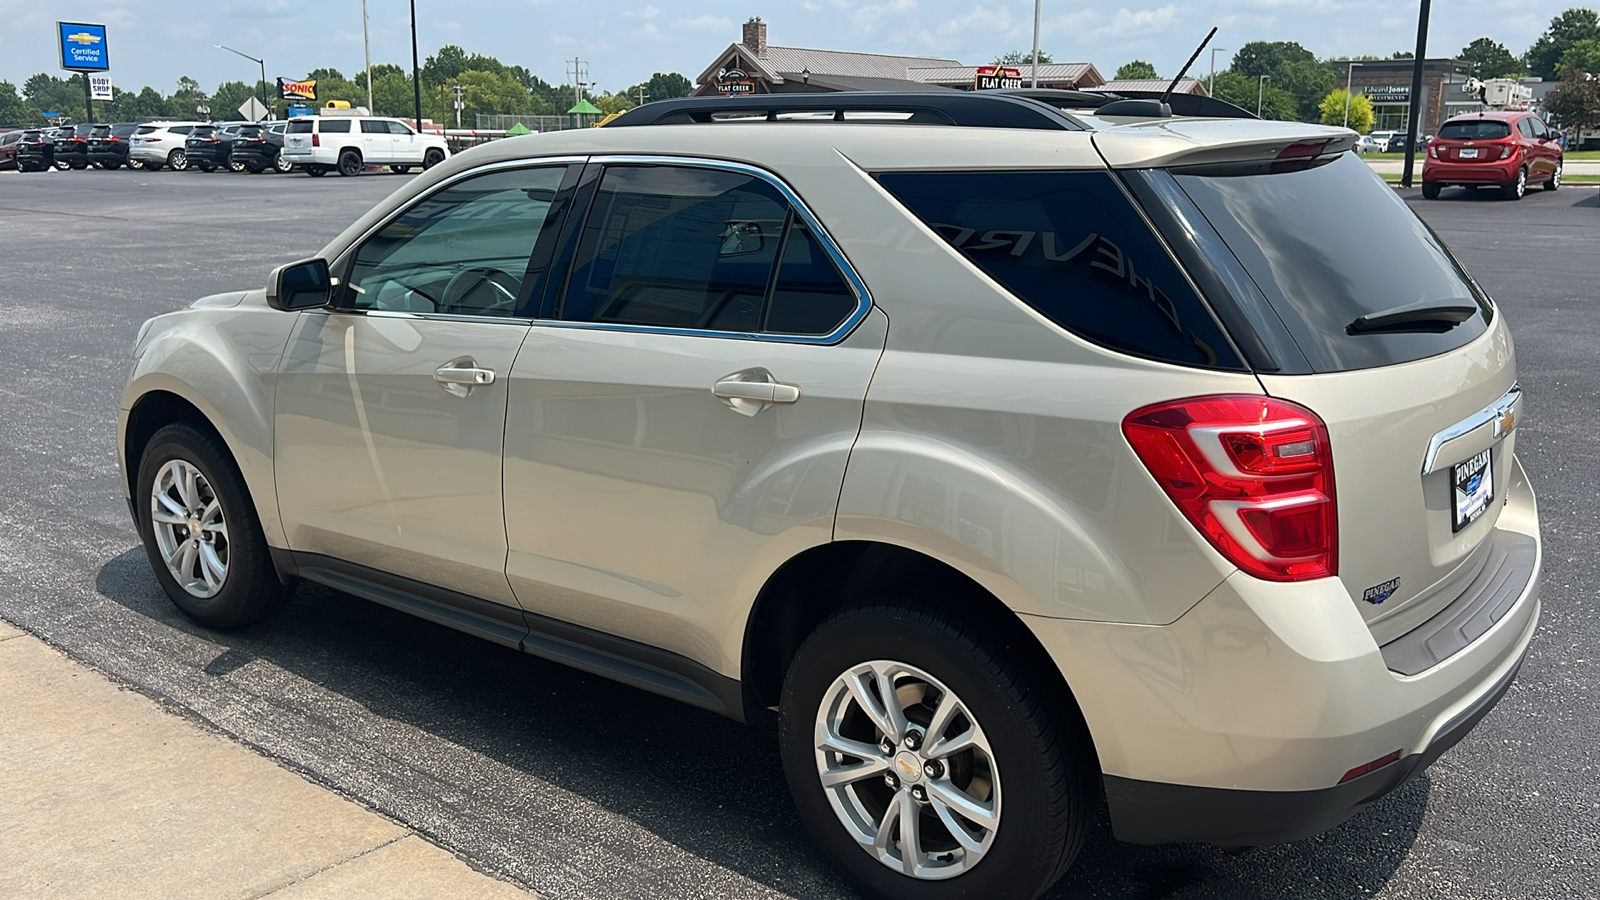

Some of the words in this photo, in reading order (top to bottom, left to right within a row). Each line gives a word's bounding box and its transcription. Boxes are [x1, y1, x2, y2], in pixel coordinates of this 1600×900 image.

[71, 47, 100, 56] Certified
[981, 77, 999, 89] FLAT
[1001, 78, 1022, 89] CREEK
[284, 84, 313, 93] SONIC
[1388, 85, 1410, 94] Jones
[1455, 450, 1488, 486] PINEGAR
[1364, 577, 1401, 600] PINEGAR
